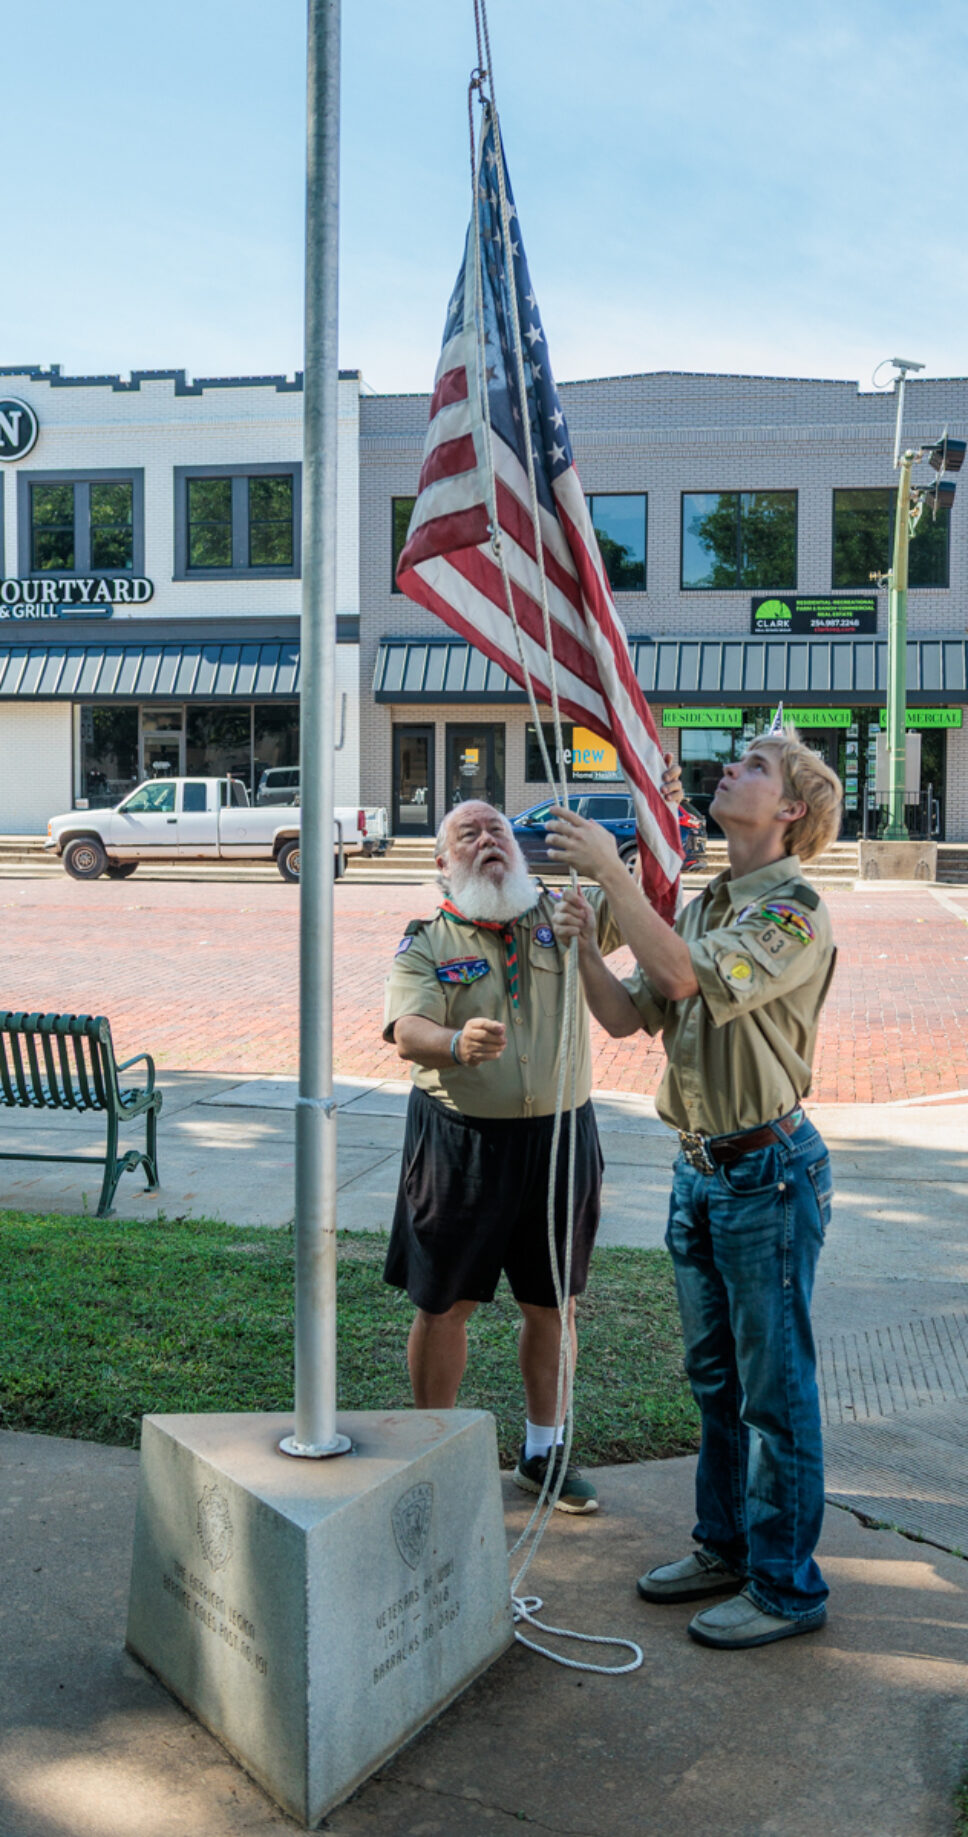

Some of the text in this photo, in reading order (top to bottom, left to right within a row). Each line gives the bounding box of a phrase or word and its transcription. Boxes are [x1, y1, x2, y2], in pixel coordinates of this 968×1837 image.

[12, 603, 59, 618] GRILL
[756, 620, 790, 628] CLARK
[664, 712, 739, 723] RESIDENTIAL
[812, 712, 849, 723] RANCH
[881, 712, 957, 723] CMERCIAL
[556, 748, 605, 764] renew
[376, 1586, 419, 1630] VETERANS
[384, 1619, 406, 1649] 1917
